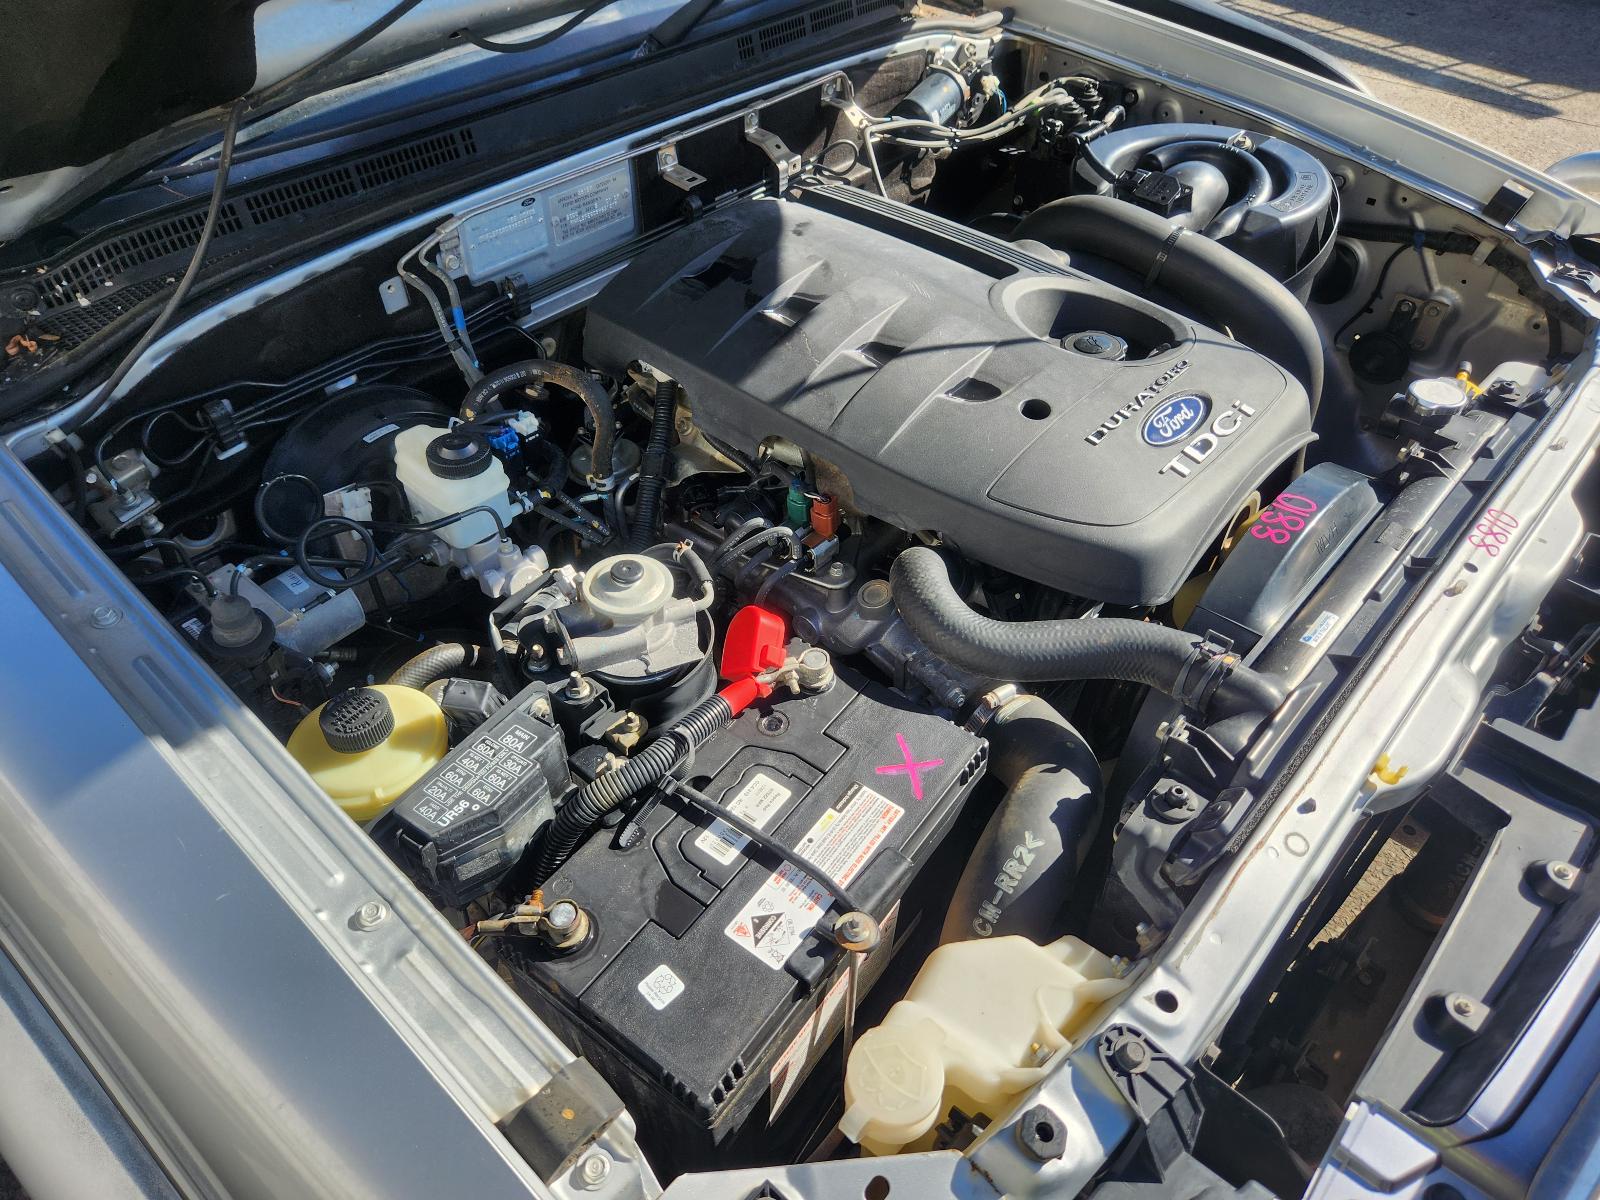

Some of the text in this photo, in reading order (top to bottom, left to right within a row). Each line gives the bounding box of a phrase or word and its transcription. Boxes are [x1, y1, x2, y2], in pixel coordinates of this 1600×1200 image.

[1084, 359, 1191, 446] DURATORQ
[1153, 403, 1193, 438] Ford
[1158, 400, 1255, 478] TDCi
[515, 730, 530, 740] MAIN
[503, 735, 524, 750] 80A
[477, 743, 494, 757] 60A
[462, 758, 479, 771] 40A
[503, 760, 521, 774] 30A
[445, 771, 463, 785] 60A
[488, 773, 507, 788] 60A
[428, 785, 447, 800] 20A
[472, 788, 491, 802] 60A
[847, 784, 859, 797] Charge
[420, 806, 437, 820] 40A
[437, 799, 470, 827] UR56
[754, 915, 777, 939] CORROSIVE
